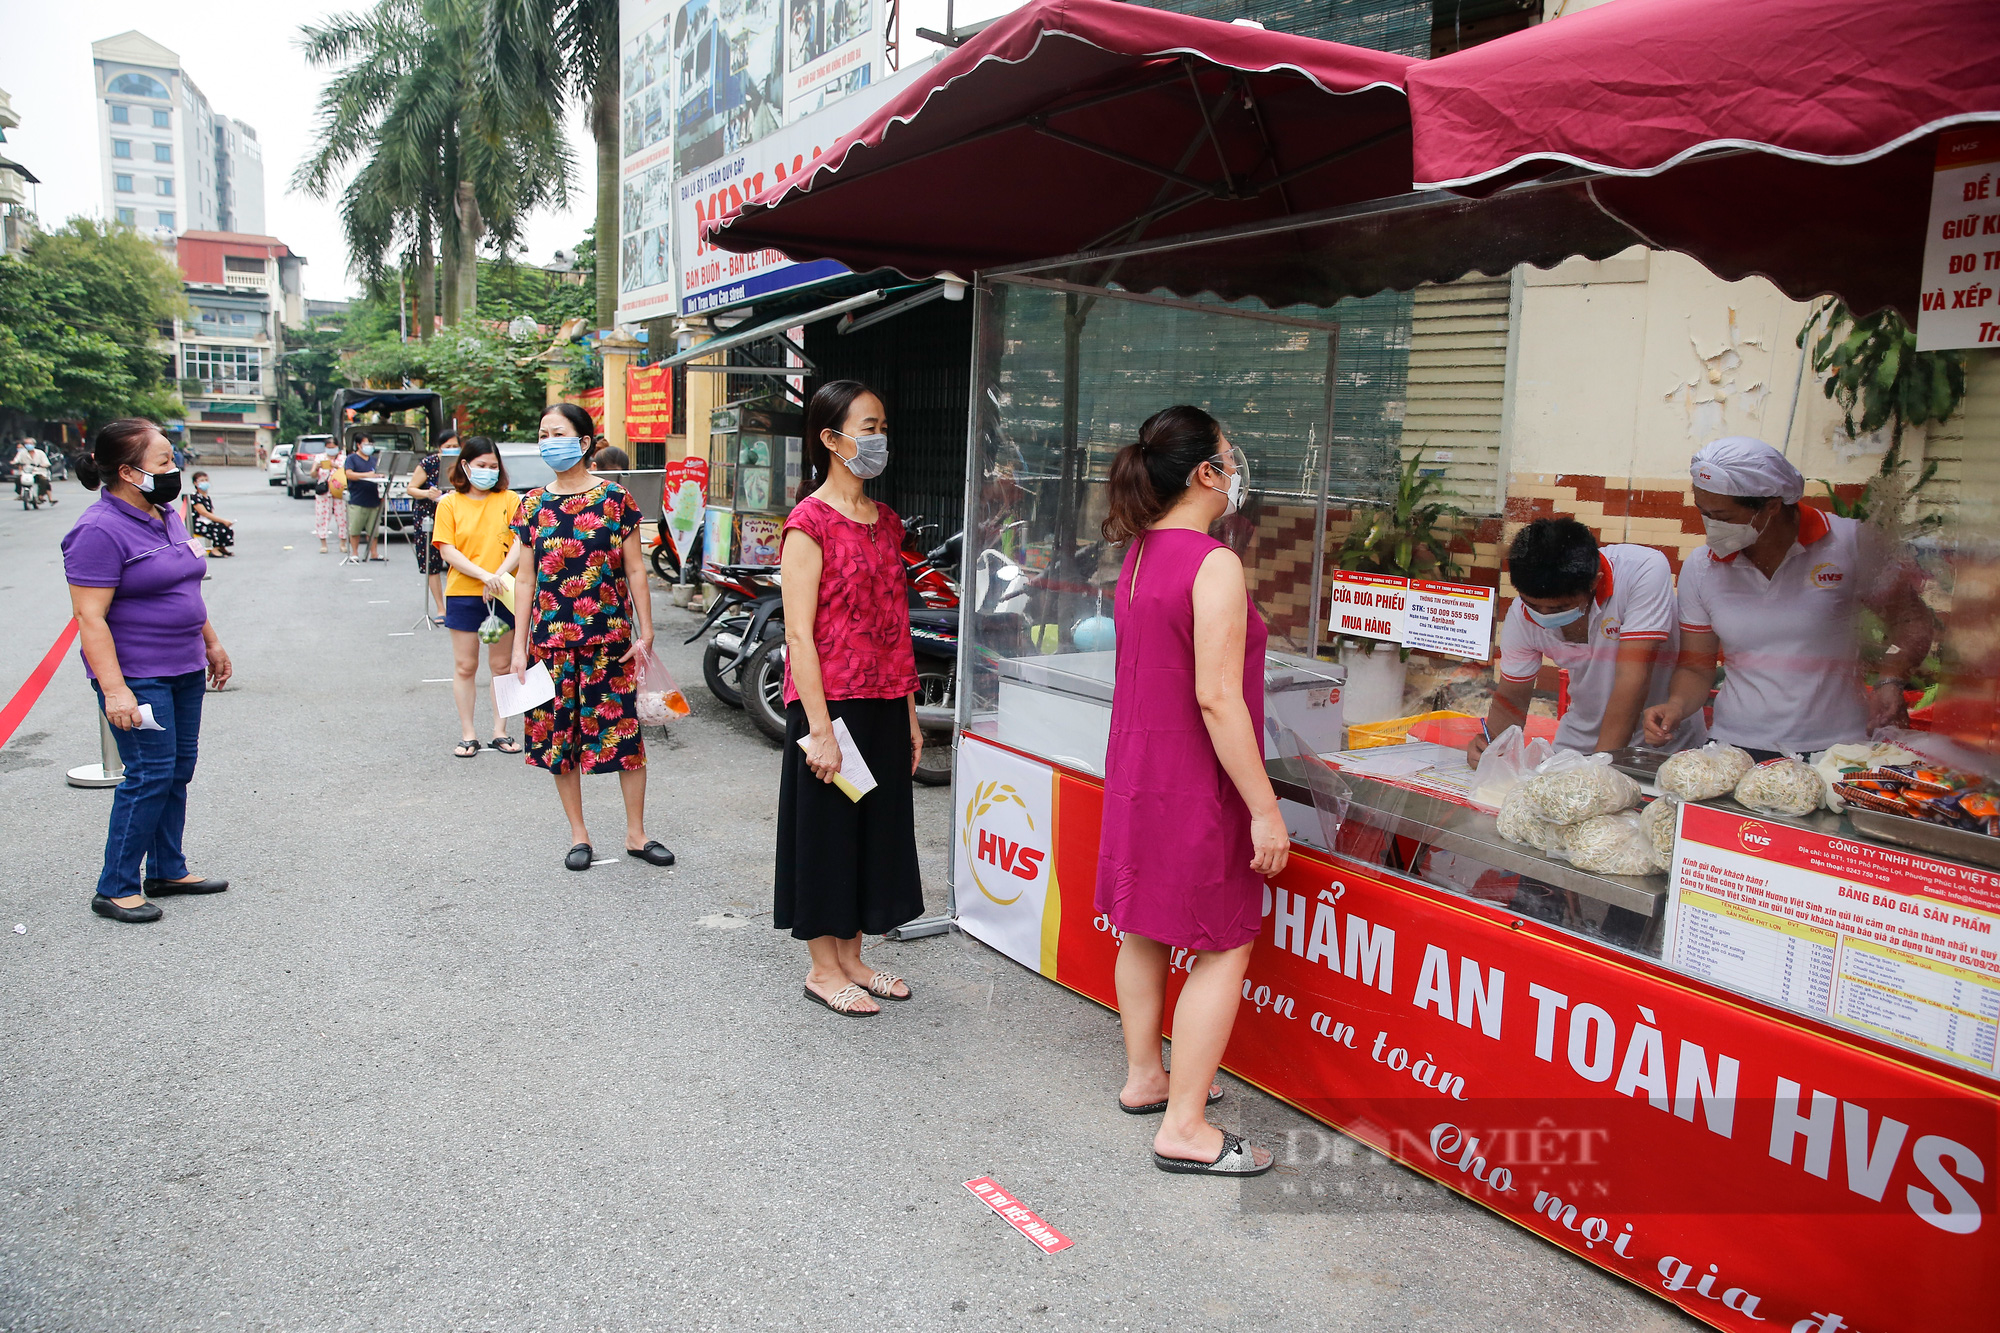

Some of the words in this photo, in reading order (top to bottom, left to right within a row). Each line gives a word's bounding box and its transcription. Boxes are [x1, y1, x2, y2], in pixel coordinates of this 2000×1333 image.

[1942, 214, 1979, 240] GIỮ
[1949, 253, 1976, 274] ĐO
[729, 285, 745, 302] street
[1922, 288, 1945, 311] VÀ
[1952, 283, 1992, 309] XẾP
[1818, 573, 1843, 582] HVS
[1333, 586, 1351, 604] CỬA
[1354, 591, 1373, 607] ĐƯA
[1375, 592, 1404, 610] PHIẾU
[1341, 615, 1362, 631] MUA
[1364, 616, 1391, 635] HÀNG
[1412, 604, 1425, 613] STK:
[1426, 607, 1437, 615] 150
[1439, 609, 1450, 617] 009
[1451, 610, 1462, 618] 555
[1464, 612, 1479, 621] 5959
[1744, 832, 1772, 846] HVS
[977, 828, 1045, 880] HVS
[1828, 840, 1859, 855] CÔNG
[1862, 847, 1876, 858] TY
[1878, 852, 1909, 866] TNHH
[1912, 860, 1957, 877] HƯƠNG
[1960, 868, 1987, 885] VIỆT
[1682, 857, 1698, 868] Kính
[1710, 864, 1723, 875] Quý
[1724, 868, 1745, 881] khách
[1745, 874, 1764, 886] hàng
[1810, 858, 1824, 868] Điện
[1846, 867, 1860, 875] 0243
[1862, 870, 1874, 879] 750
[1875, 874, 1890, 882] 1459
[1872, 863, 1889, 872] Phúc
[1934, 877, 1952, 888] Phúc
[1968, 885, 1988, 897] Quận
[1923, 885, 1946, 897] Email:
[1706, 873, 1718, 884] tiên
[1720, 877, 1736, 890] công
[1737, 882, 1744, 892] ty
[1746, 884, 1764, 897] TNHH
[1765, 890, 1788, 904] Hương
[1790, 896, 1804, 909] Việt
[1805, 901, 1823, 913] Sinh
[1824, 907, 1837, 917] xin
[1838, 910, 1851, 922] gửi
[1865, 917, 1883, 930] cảm
[1885, 922, 1895, 932] ơn
[1897, 926, 1919, 940] chân
[1921, 931, 1945, 947] thành
[1947, 938, 1968, 951] nhất
[1969, 944, 1978, 954] vì
[1980, 947, 1997, 960] quý
[1838, 885, 1869, 903] BẢNG
[1872, 893, 1896, 910] BÁO
[1899, 901, 1919, 916] GIÁ
[1923, 907, 1949, 924] SẢN
[1953, 916, 1991, 934] PHẨM
[1680, 877, 1697, 889] Công
[1698, 881, 1704, 890] ty
[1705, 884, 1725, 898] Hương
[1727, 890, 1740, 901] Việt
[1741, 894, 1756, 905] Sinh
[1758, 898, 1770, 908] xin
[1771, 902, 1782, 913] gửi
[1795, 909, 1809, 921] quý
[1810, 914, 1834, 927] khách
[1836, 922, 1855, 934] hàng
[1857, 927, 1872, 938] báo
[1874, 930, 1887, 943] giá
[1889, 934, 1900, 946] áp
[1902, 938, 1923, 952] dụng
[1935, 947, 1957, 962] ngày
[1959, 953, 2000, 971] 05/09/20
[1310, 1010, 1357, 1049] an
[1371, 1031, 1468, 1101] toàn
[1412, 944, 1505, 1041] AN
[1528, 982, 1740, 1139] TOÀN
[1768, 1076, 1986, 1235] HVS
[1022, 1222, 1059, 1247] HÀNG
[1430, 1122, 1516, 1192] Cho
[1532, 1190, 1634, 1259] mọi
[1657, 1253, 1766, 1321] gia
